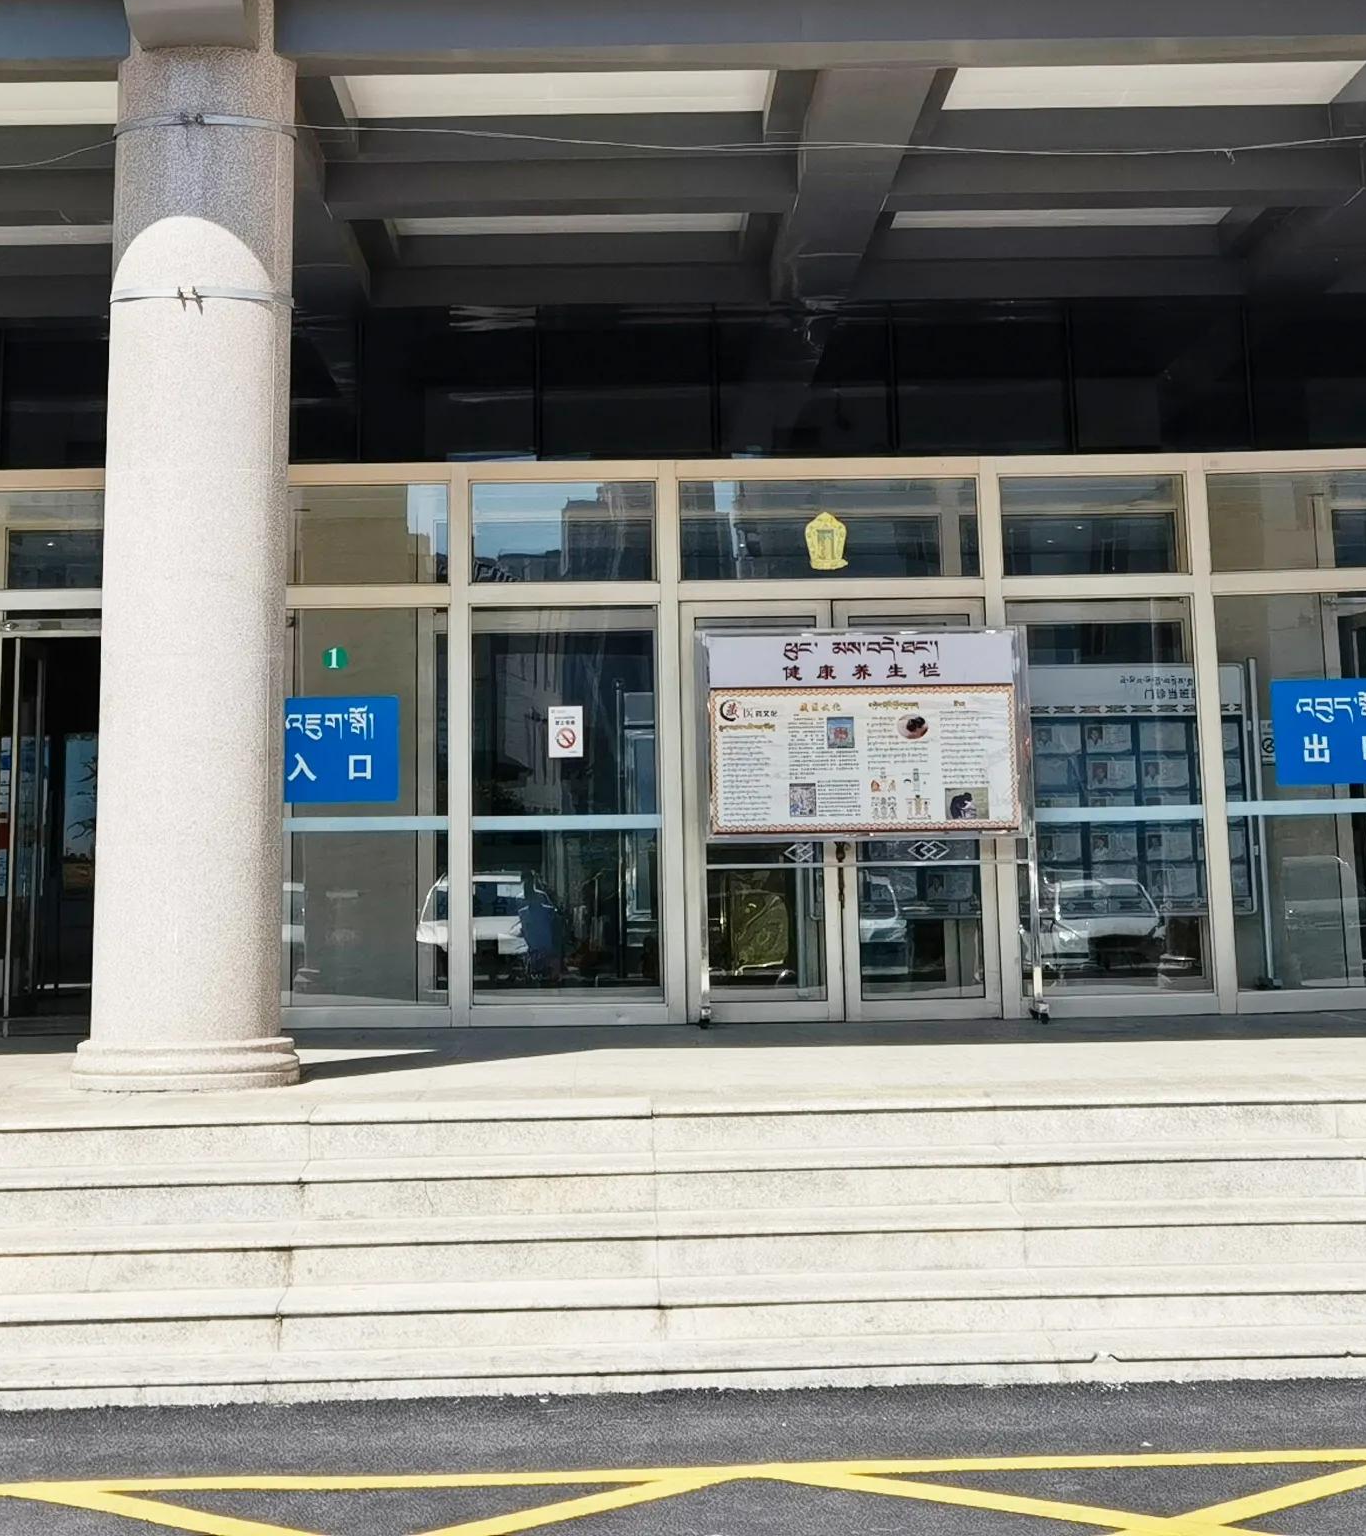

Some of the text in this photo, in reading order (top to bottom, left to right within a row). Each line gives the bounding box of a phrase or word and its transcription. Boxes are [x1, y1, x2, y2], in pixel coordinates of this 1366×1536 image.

[327, 648, 339, 669] 1
[782, 662, 941, 681] 健康养生栏
[287, 752, 372, 782] 入口
